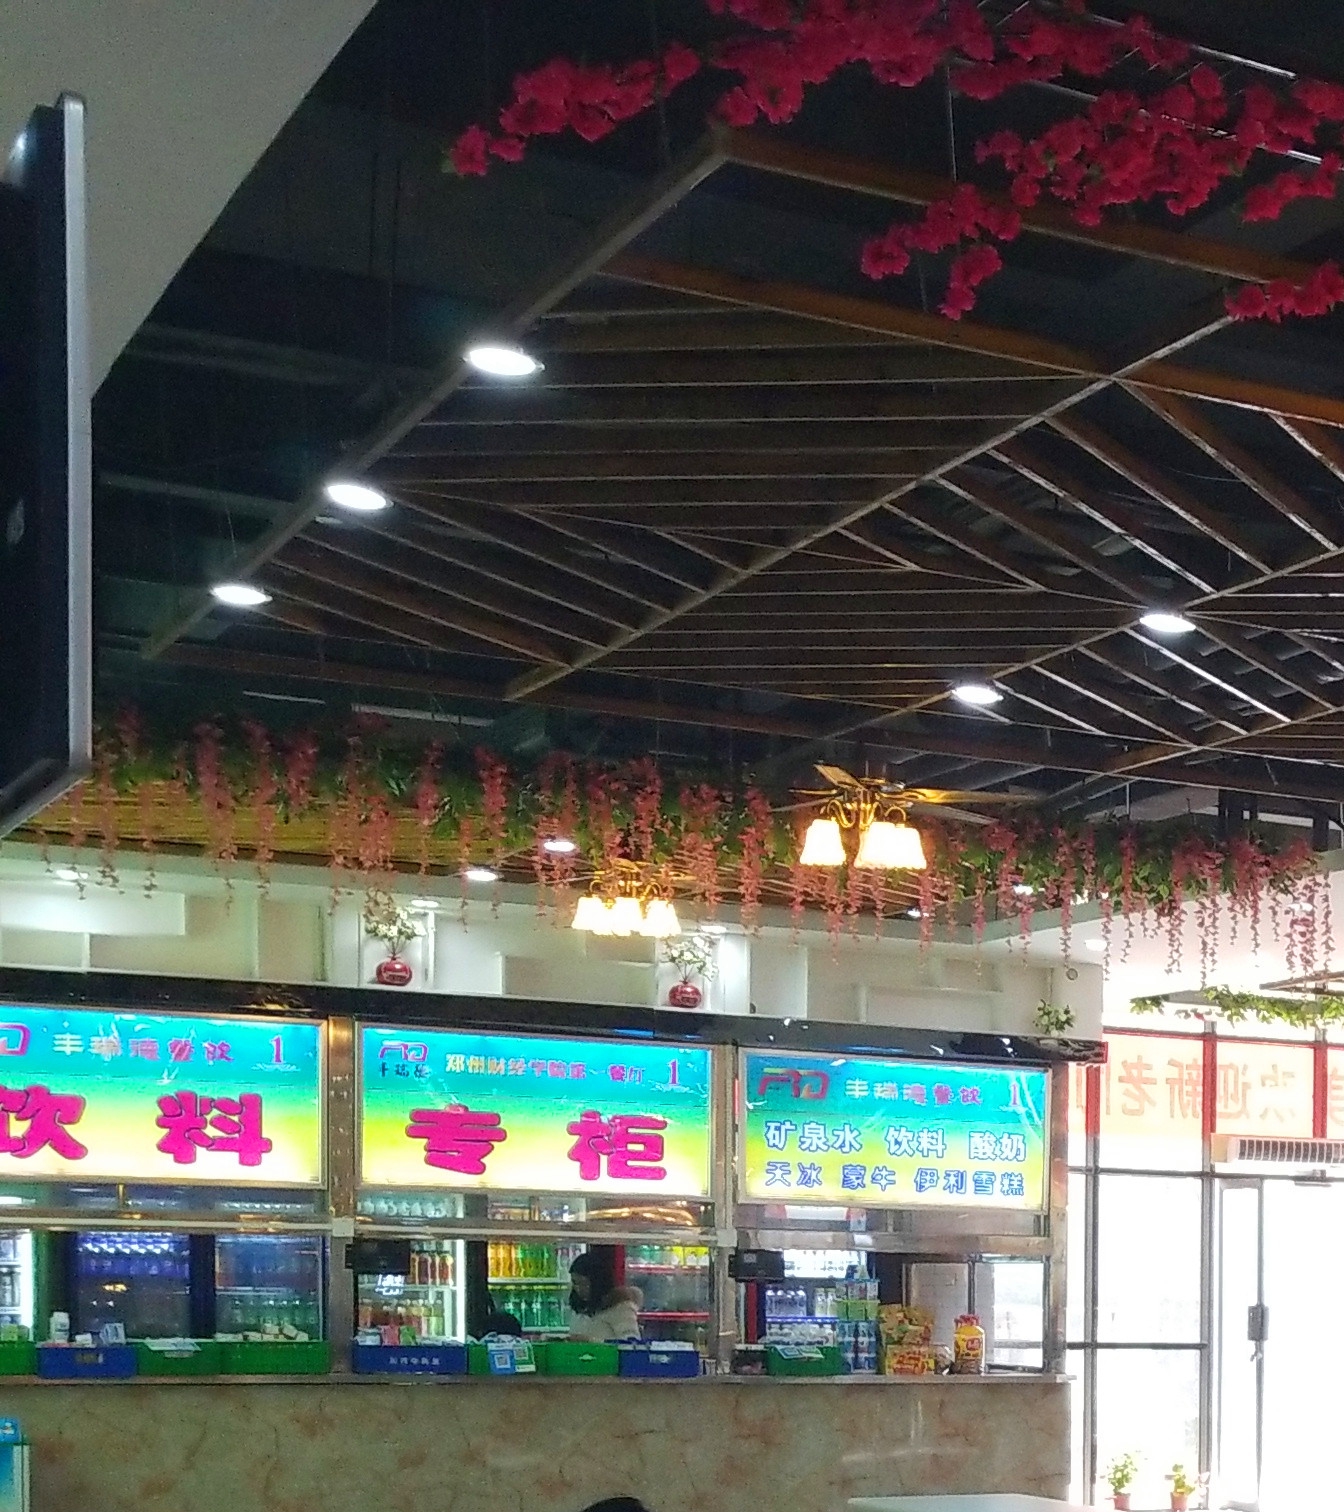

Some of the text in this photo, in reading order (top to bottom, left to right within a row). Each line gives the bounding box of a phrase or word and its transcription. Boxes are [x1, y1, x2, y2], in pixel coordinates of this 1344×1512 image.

[271, 1035, 284, 1065] 1
[667, 1059, 681, 1086] 1
[0, 1084, 273, 1167] 饮料
[405, 1103, 668, 1181] 专柜
[764, 1120, 1027, 1162] 矿泉水 饮料 酸奶
[765, 1161, 1025, 1196] 天冰 蒙牛 伊利雪糕
